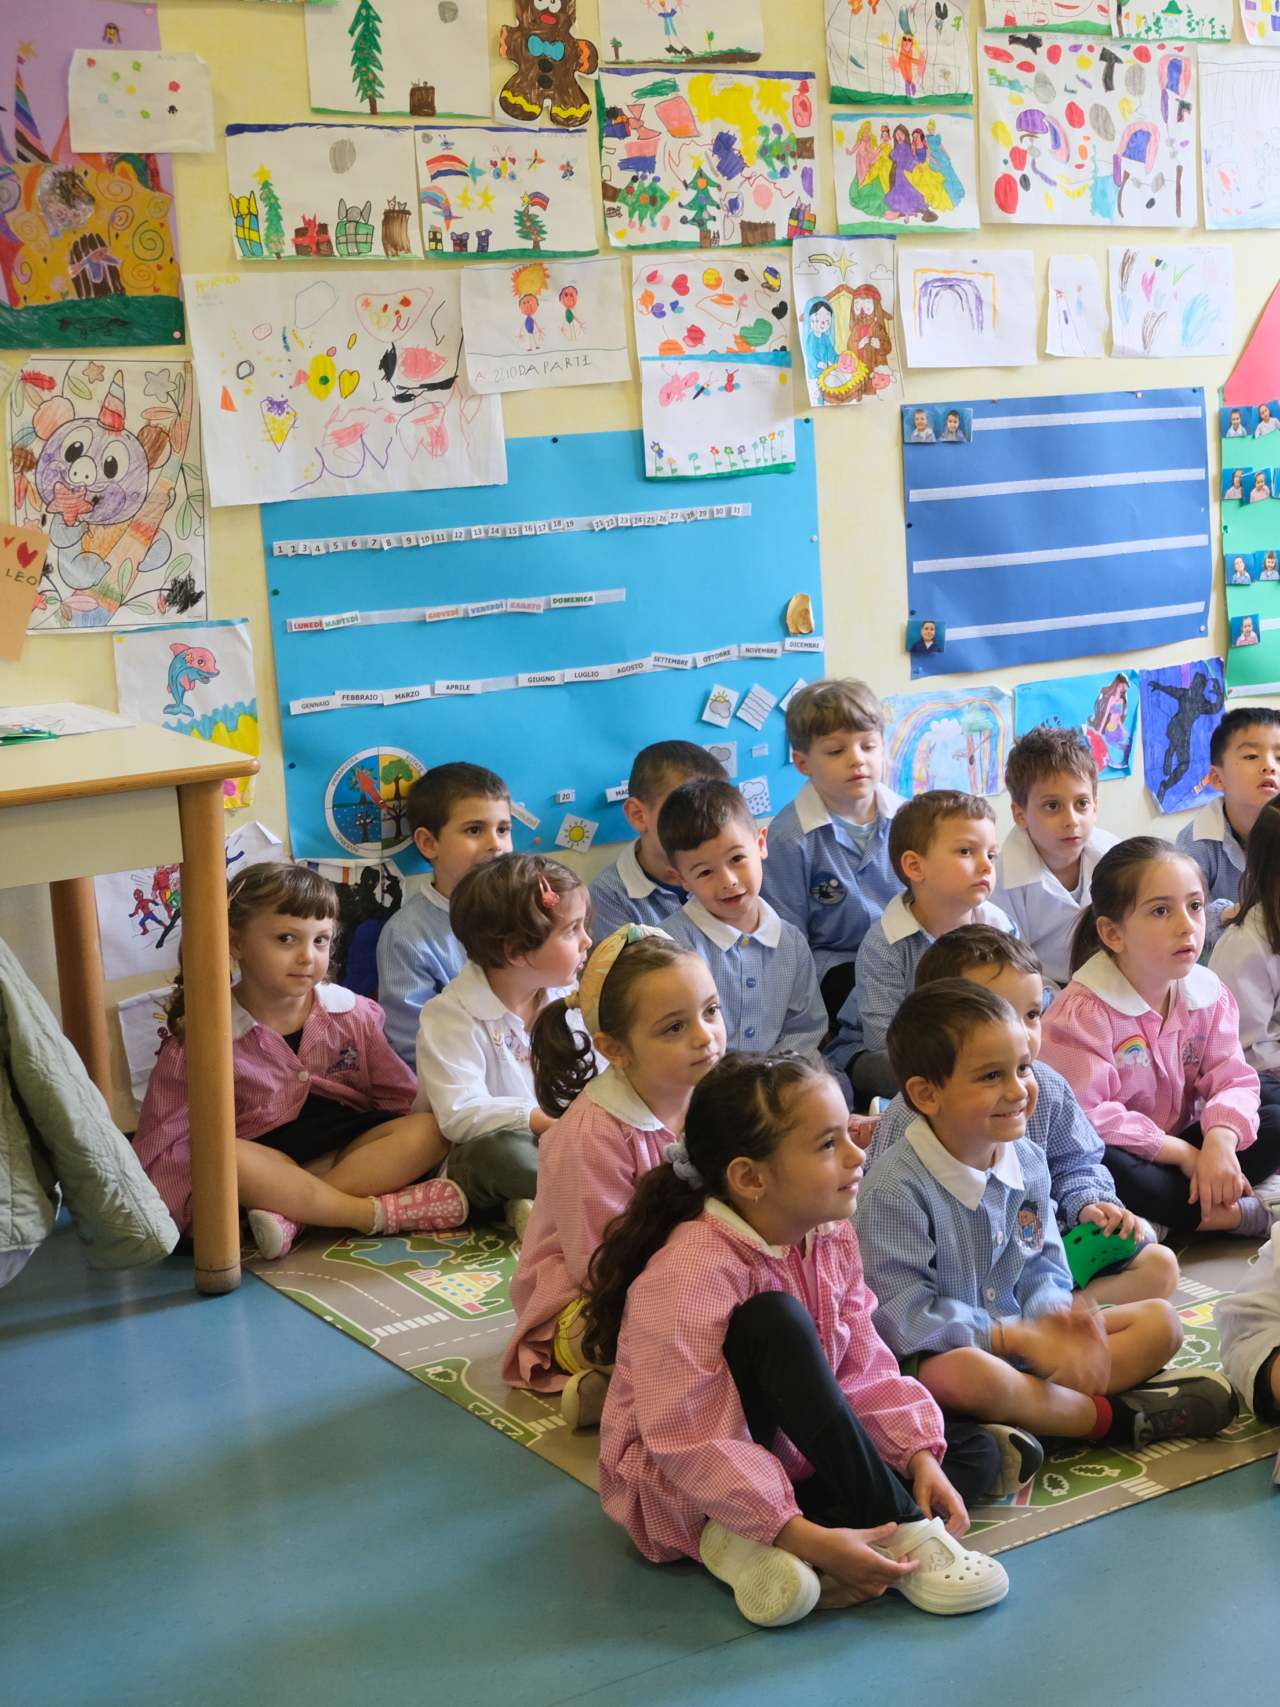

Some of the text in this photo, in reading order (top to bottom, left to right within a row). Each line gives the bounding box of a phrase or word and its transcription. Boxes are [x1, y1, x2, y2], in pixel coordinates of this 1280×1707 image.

[333, 542, 338, 550] 5
[386, 539, 391, 547] 8
[421, 535, 430, 543] 10
[474, 528, 482, 536] 13
[538, 524, 546, 532] 17
[554, 519, 562, 527] 18
[566, 520, 574, 528] 19
[595, 519, 604, 528] 21
[606, 519, 614, 527] 22
[659, 515, 667, 523] 26
[686, 510, 695, 519] 28
[5, 568, 38, 586] LEO
[294, 596, 594, 629] LUNEDÌ MARTEDÌ GIOVEDÌ VENERDÌ SABATO DOMENICA
[301, 700, 330, 709] GENNAIO
[395, 691, 420, 700] MARZO
[616, 663, 644, 674] AGOSTO
[653, 656, 689, 666] SETTEMBRE
[703, 650, 731, 663] OTTOBRE
[790, 641, 820, 649] DICEMBRE
[331, 756, 359, 786] PRIMAVERA
[405, 755, 424, 772] ESTATE
[335, 833, 360, 853] INVERNO
